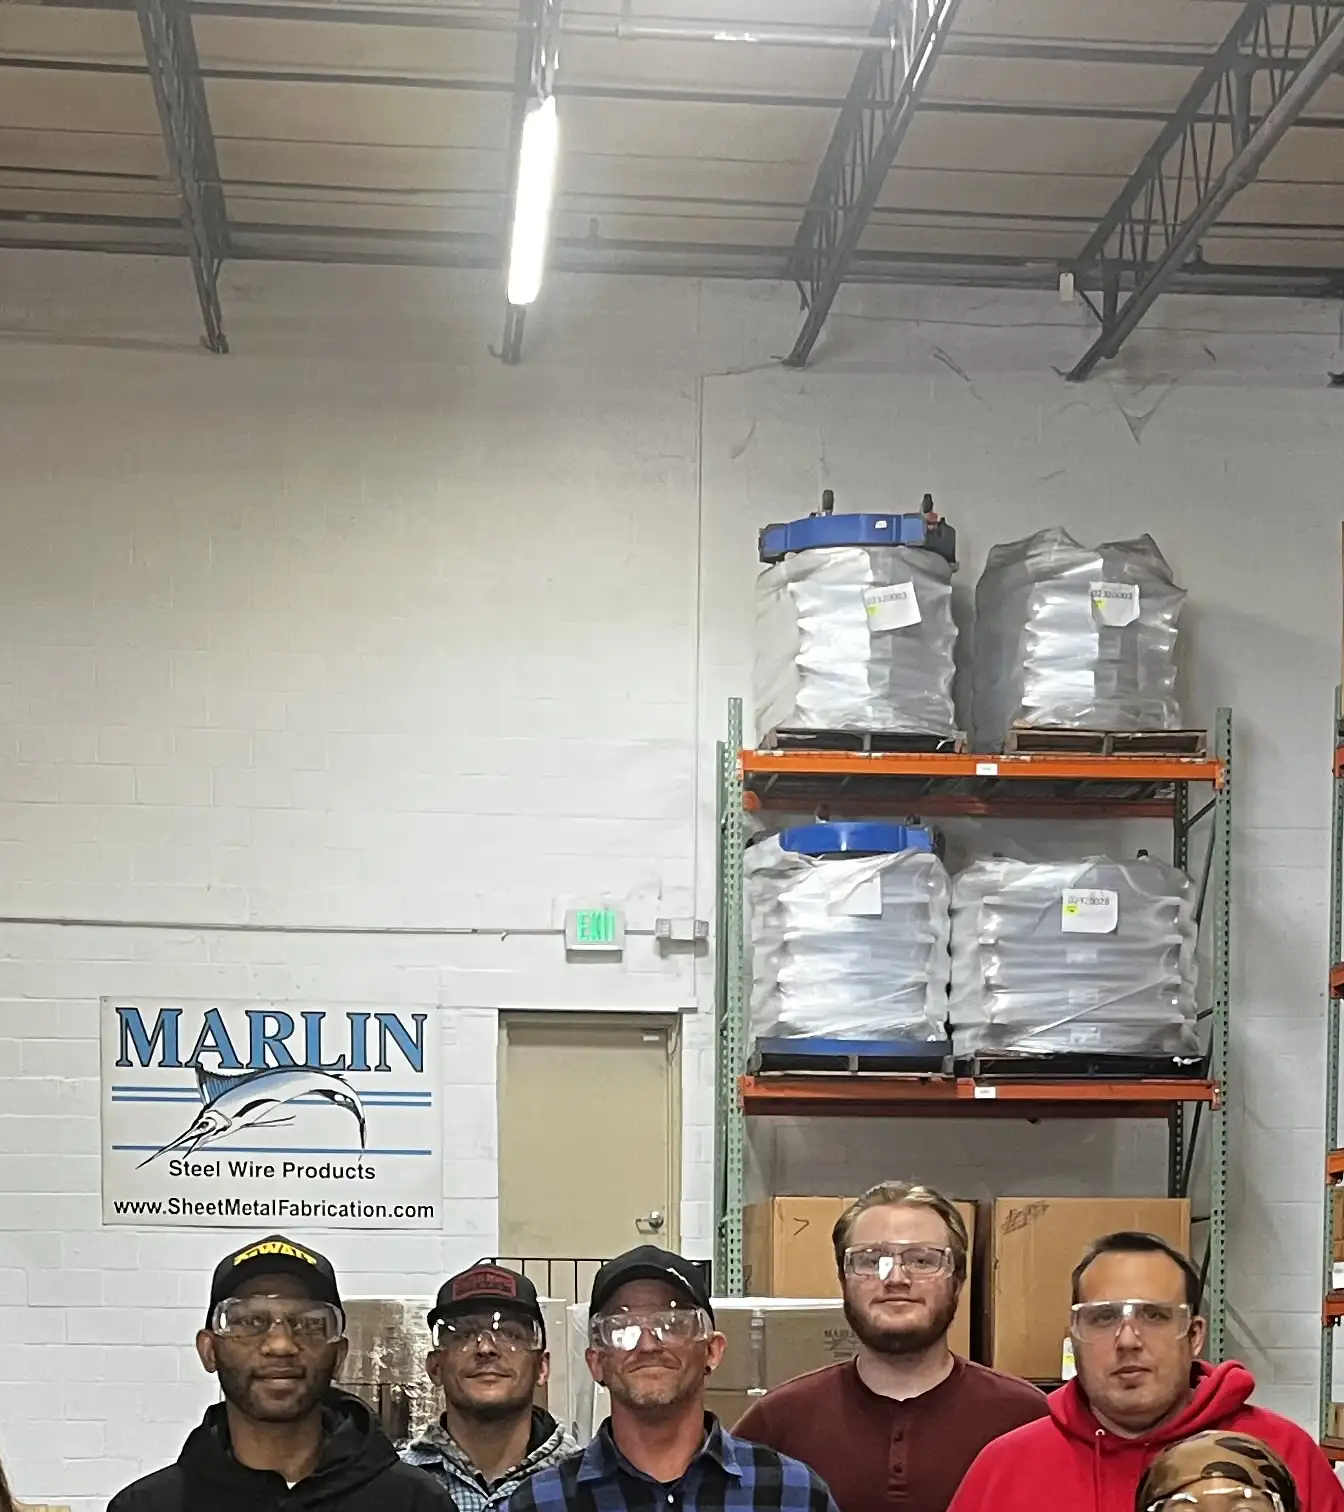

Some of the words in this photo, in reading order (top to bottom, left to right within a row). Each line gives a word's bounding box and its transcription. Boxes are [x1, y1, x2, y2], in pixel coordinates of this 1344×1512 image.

[115, 1006, 428, 1073] MARLIN
[168, 1160, 221, 1178] Steel
[228, 1161, 275, 1178] Wire
[282, 1162, 376, 1180] Products
[113, 1197, 435, 1218] www.SheetMetalFabrication.com
